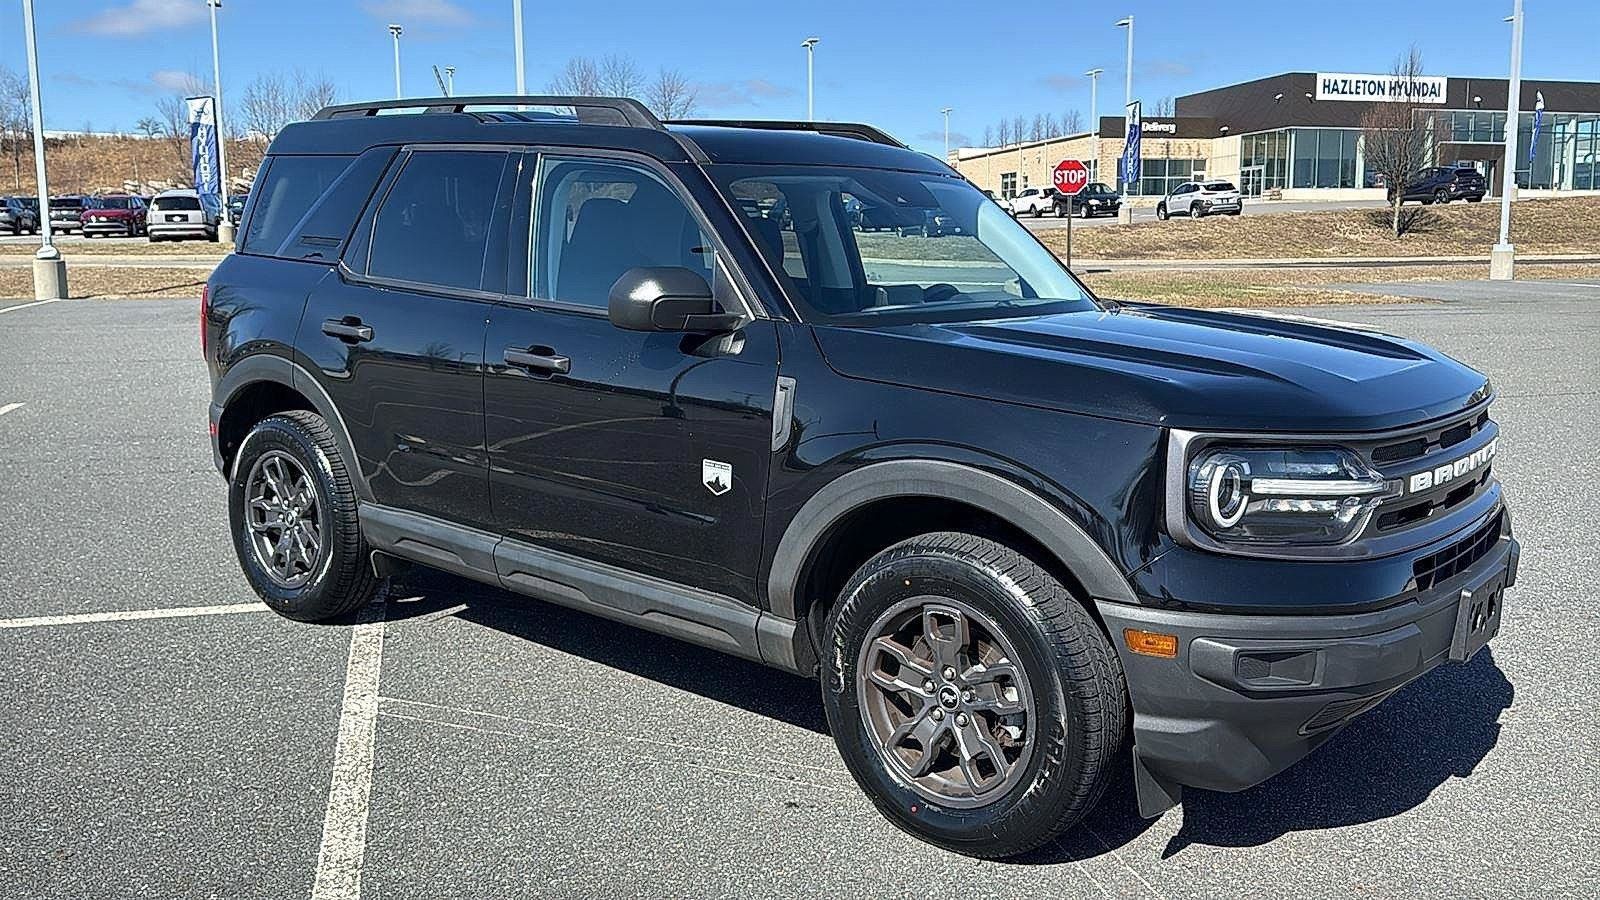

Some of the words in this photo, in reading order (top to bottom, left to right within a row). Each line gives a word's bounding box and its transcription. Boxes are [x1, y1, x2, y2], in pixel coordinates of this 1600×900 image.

[1322, 79, 1386, 96] HAZLETON
[1388, 80, 1441, 97] HYUNDAI
[1142, 122, 1176, 133] Delivery
[1054, 169, 1086, 184] STOP
